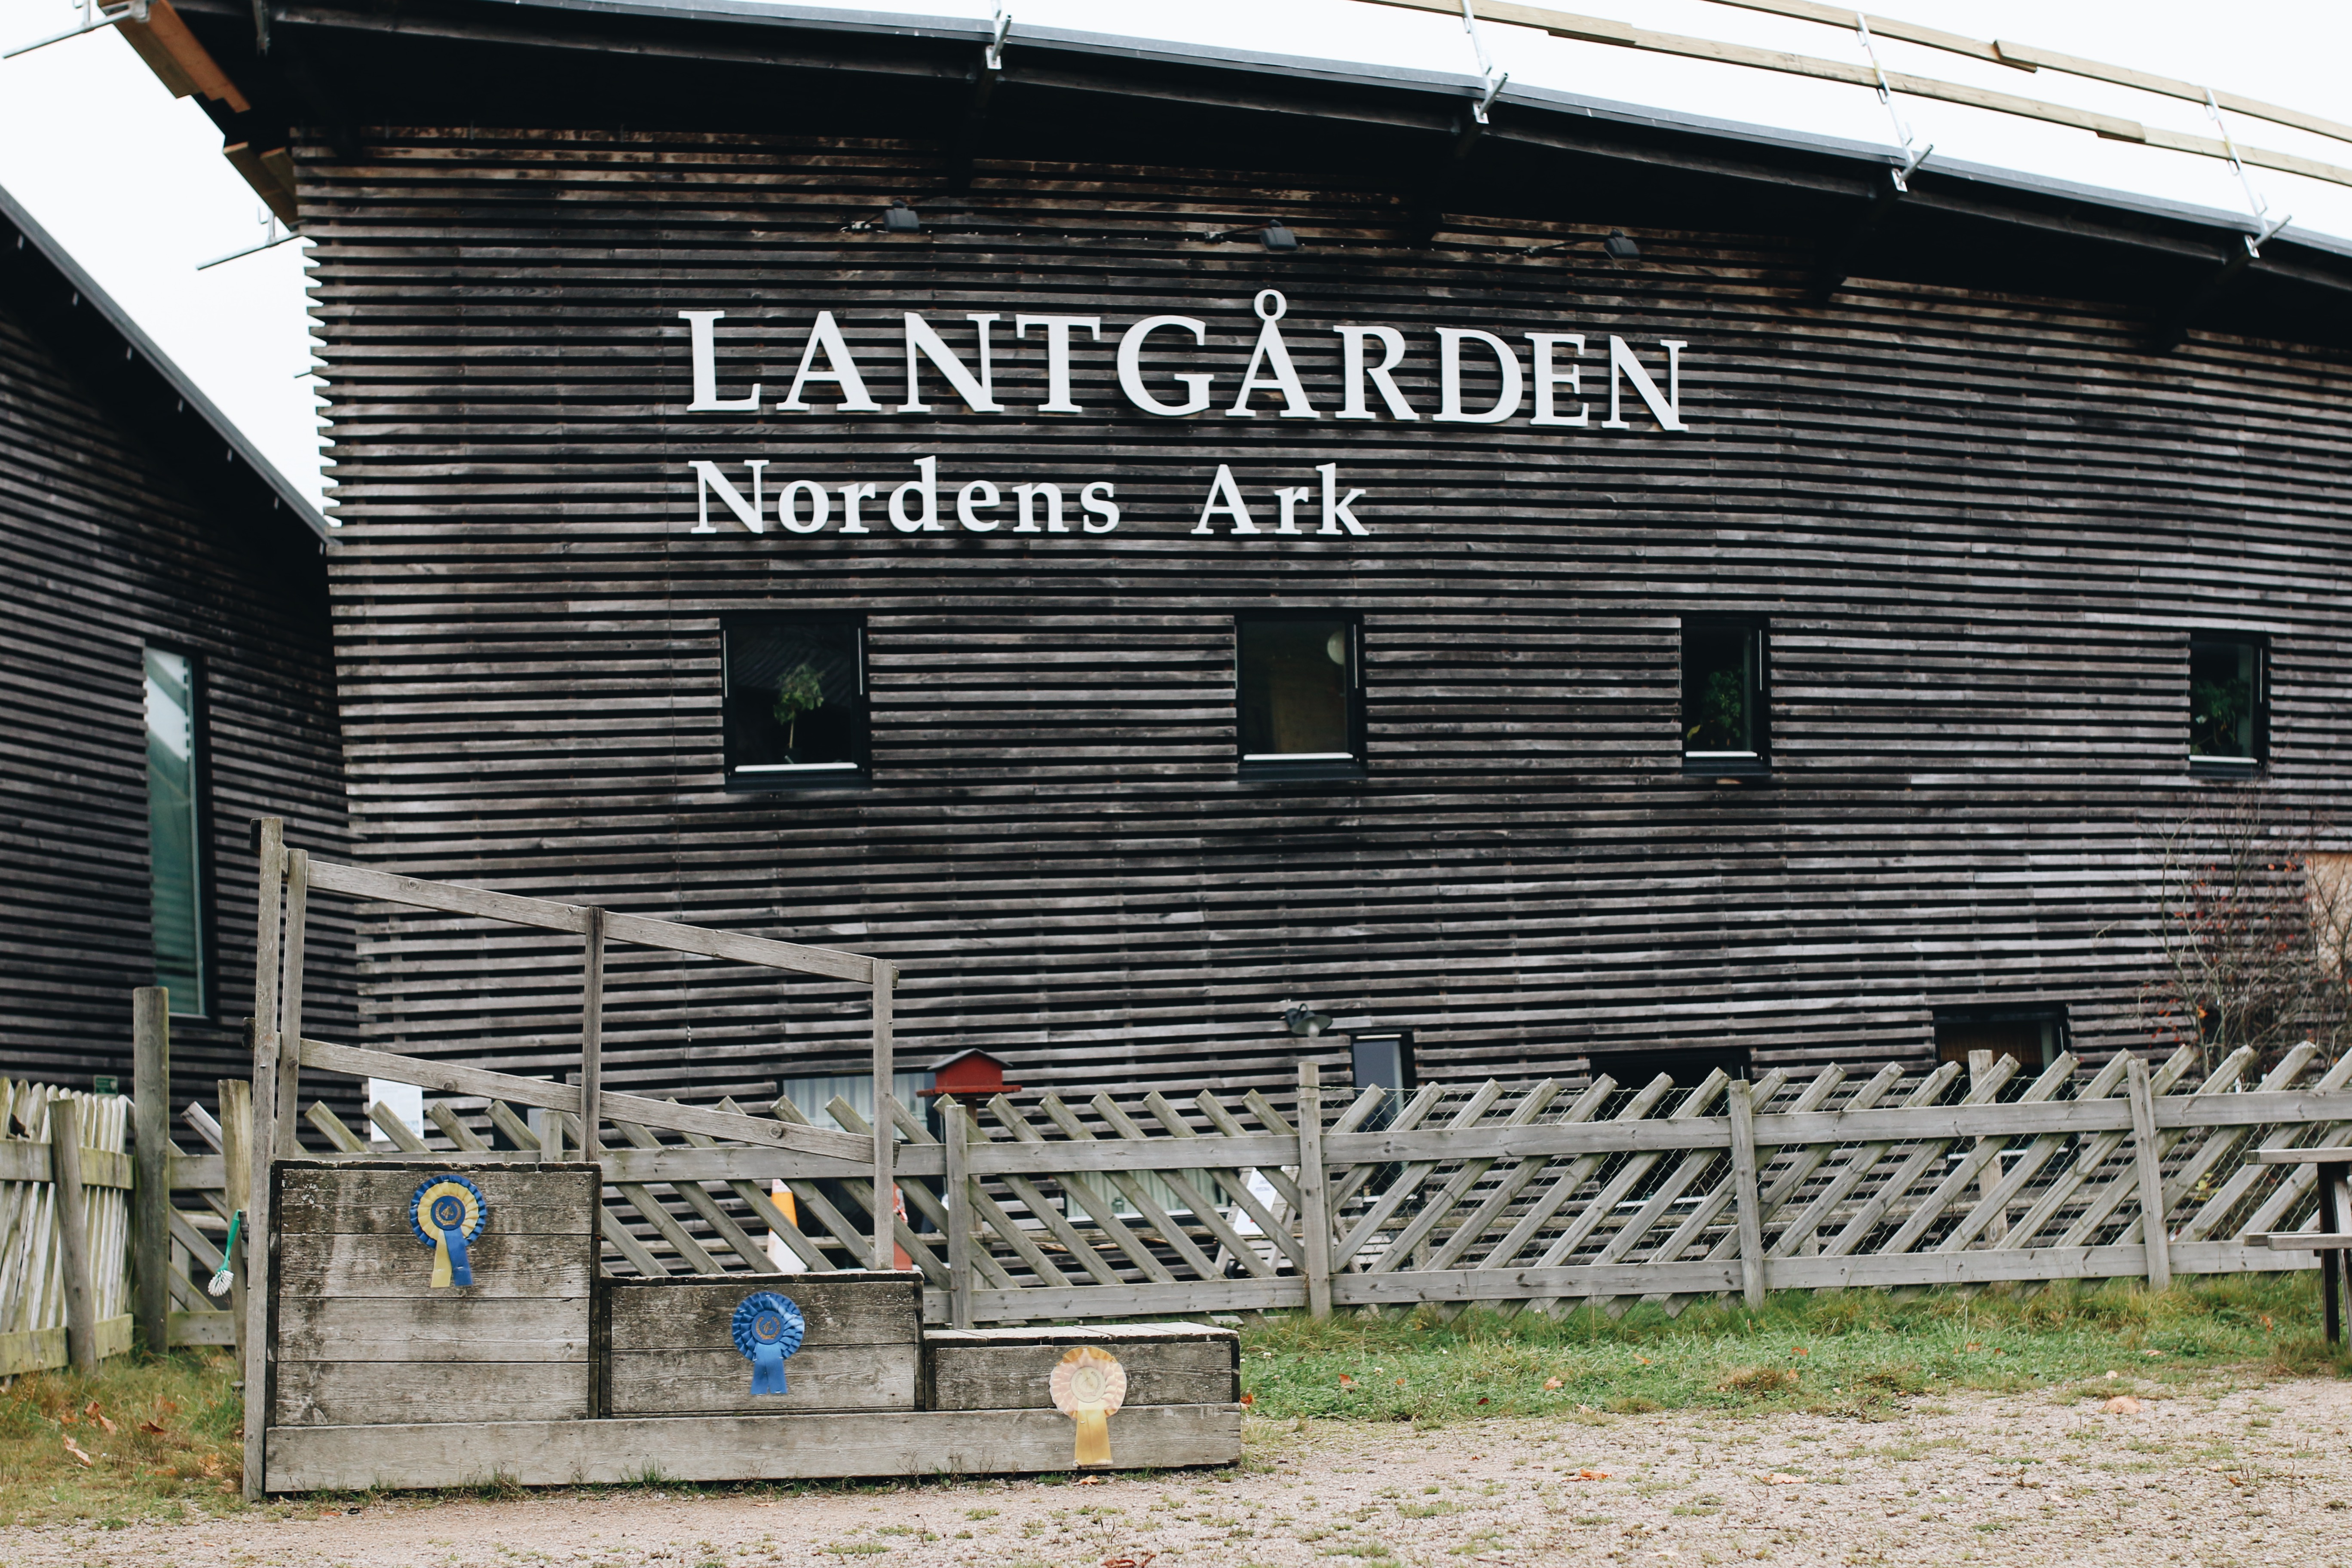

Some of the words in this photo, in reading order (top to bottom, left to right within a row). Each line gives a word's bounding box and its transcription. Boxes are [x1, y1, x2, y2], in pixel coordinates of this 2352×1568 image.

[677, 288, 1690, 432] LANTGÅRDEN
[687, 455, 1120, 534] Nordens
[1190, 462, 1370, 536] Ark
